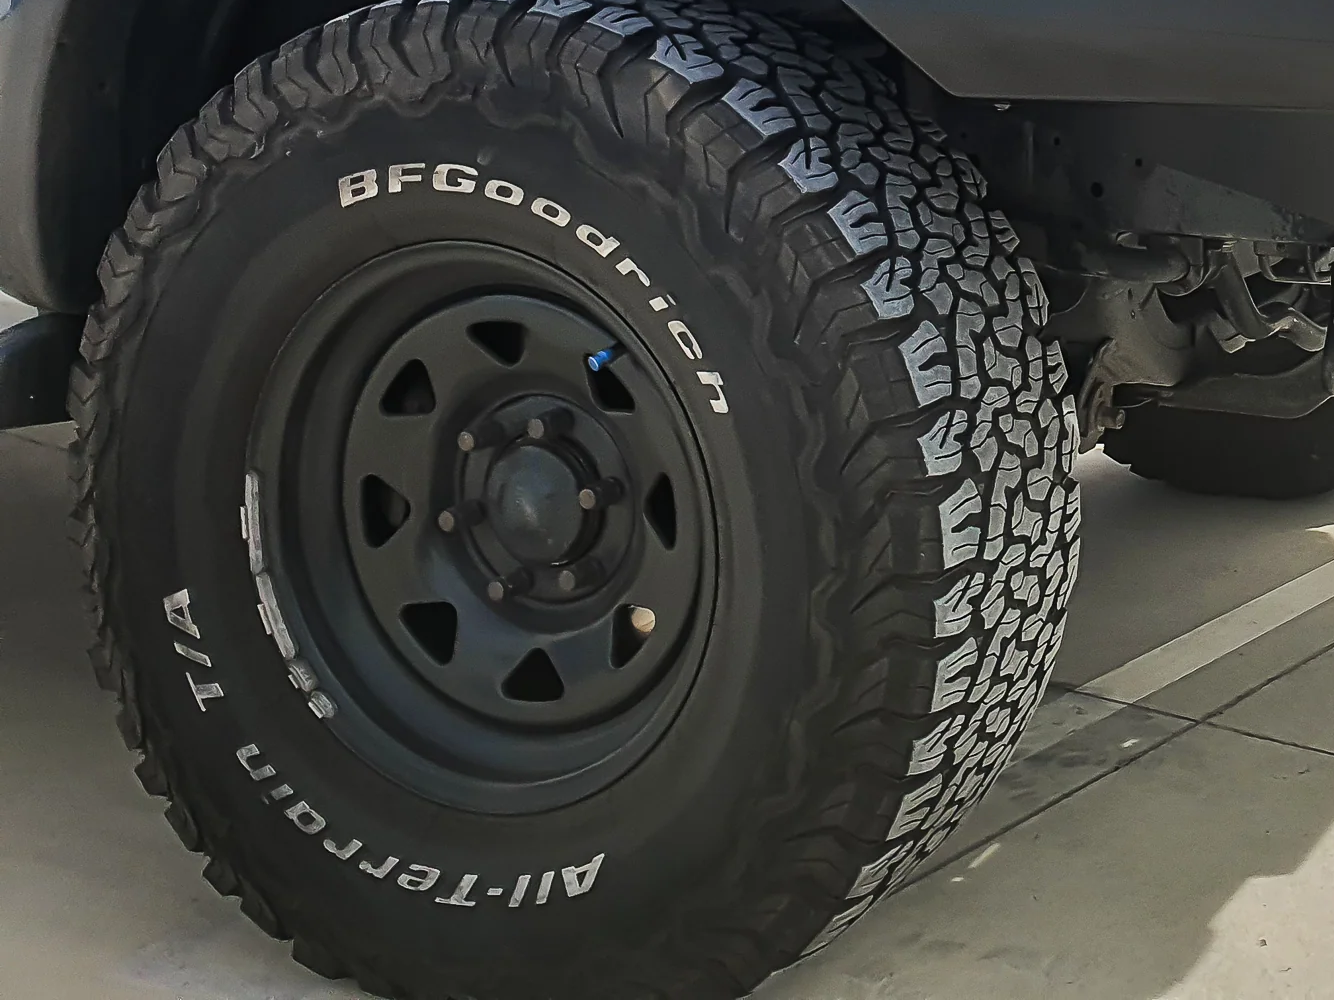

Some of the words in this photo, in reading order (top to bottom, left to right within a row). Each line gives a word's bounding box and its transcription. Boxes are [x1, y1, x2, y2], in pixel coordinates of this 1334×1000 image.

[338, 163, 729, 415] BFGoodrich
[163, 588, 225, 712] T/A
[235, 743, 605, 908] All-Terrain
